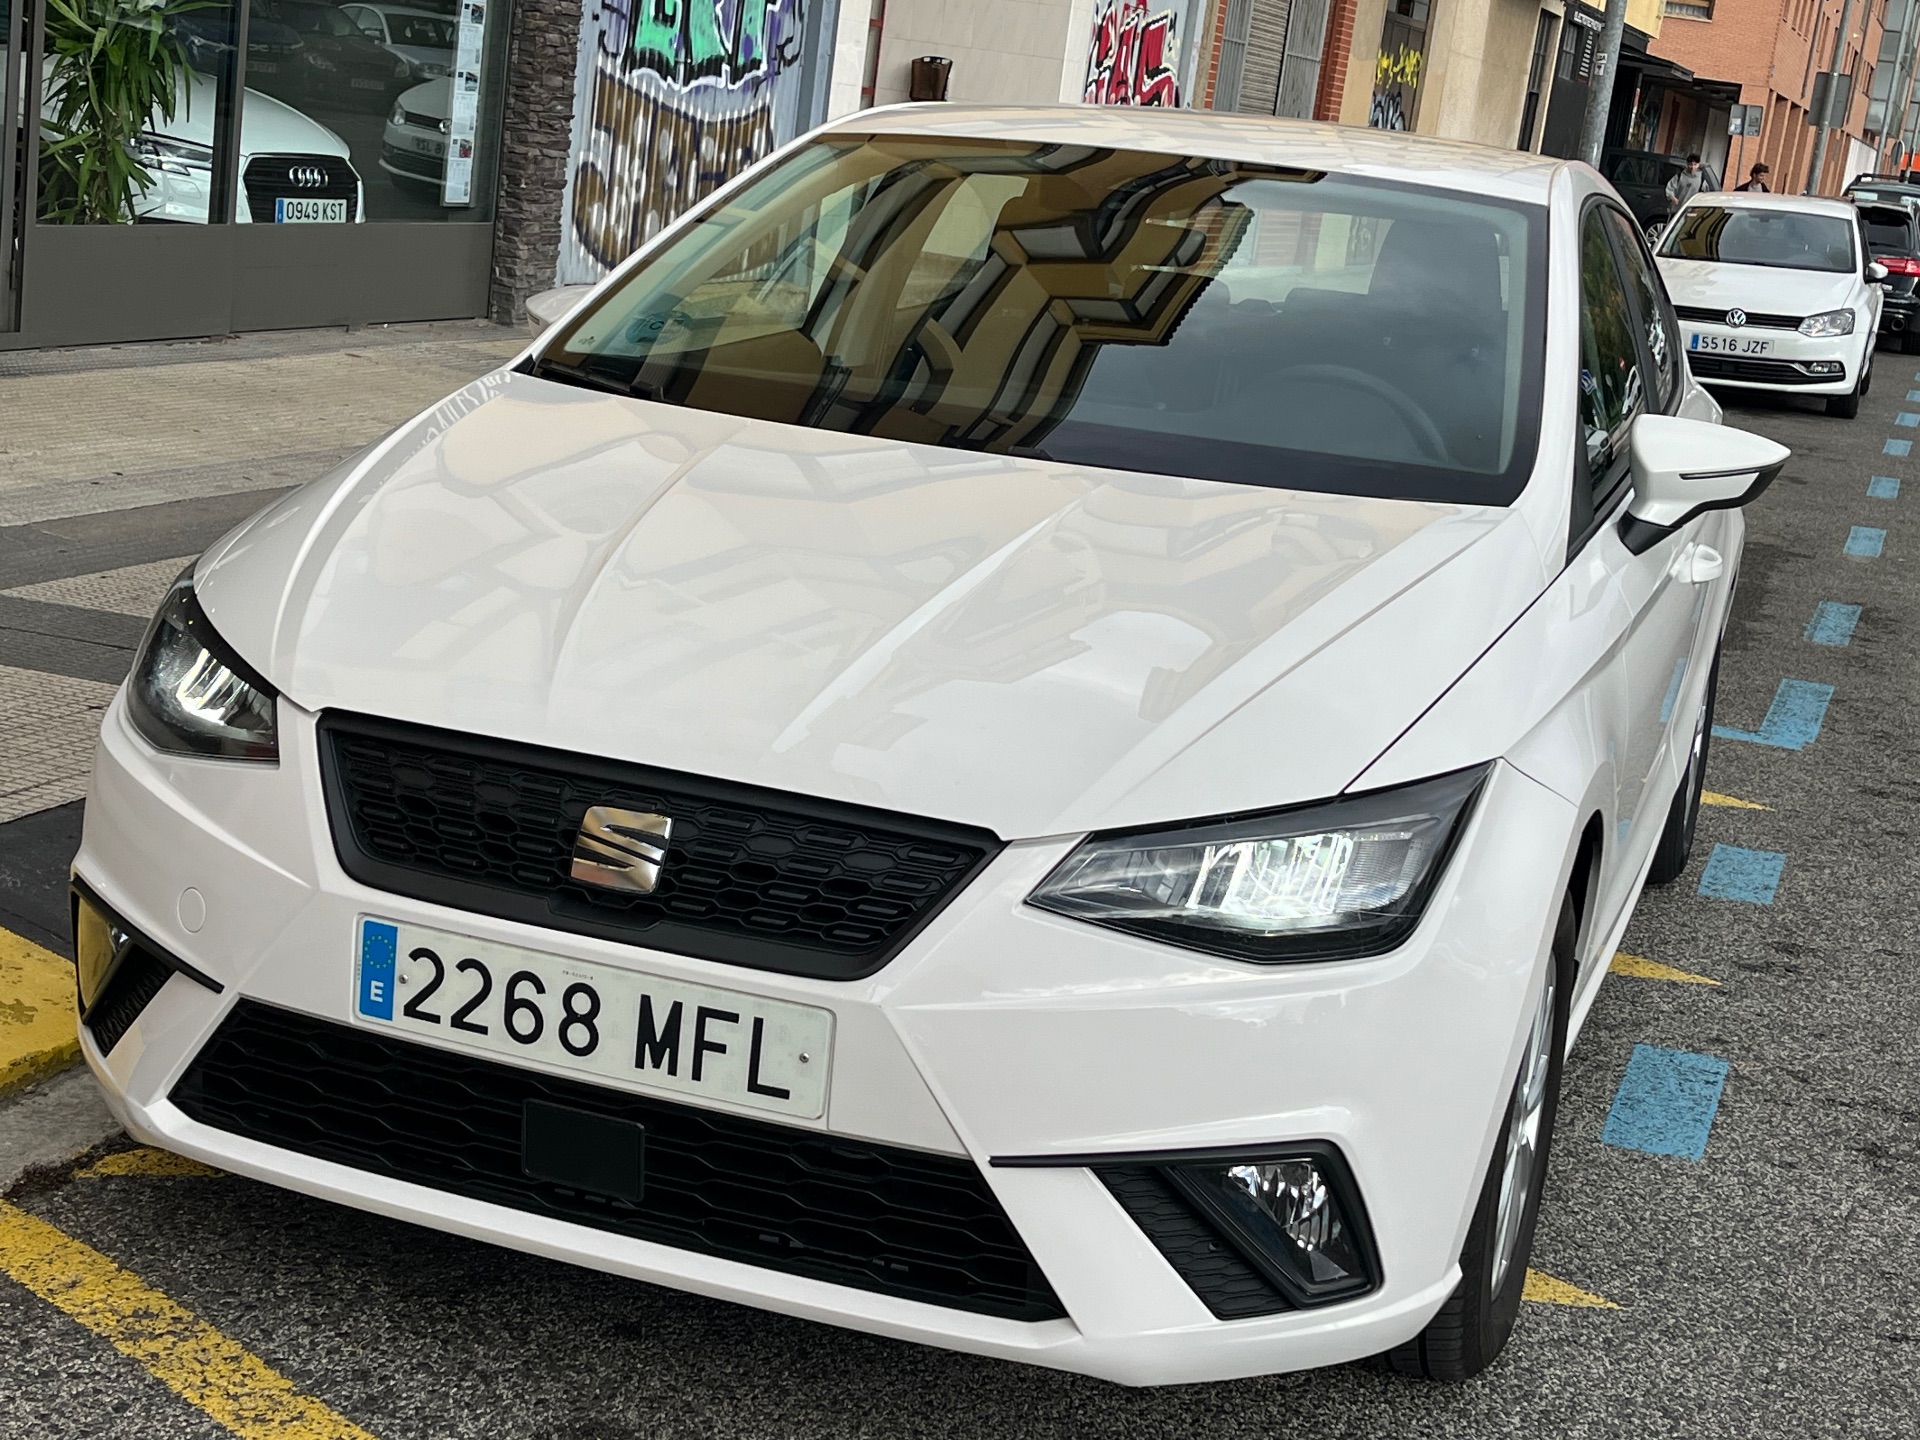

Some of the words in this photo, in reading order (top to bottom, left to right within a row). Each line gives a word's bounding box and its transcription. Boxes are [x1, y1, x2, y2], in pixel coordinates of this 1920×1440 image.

[286, 201, 319, 220] 0949
[322, 202, 344, 221] KST
[1701, 336, 1738, 352] 5516
[1741, 340, 1769, 354] JZF
[369, 979, 385, 1003] E
[402, 946, 602, 1057] 2268
[633, 993, 791, 1101] MFL
